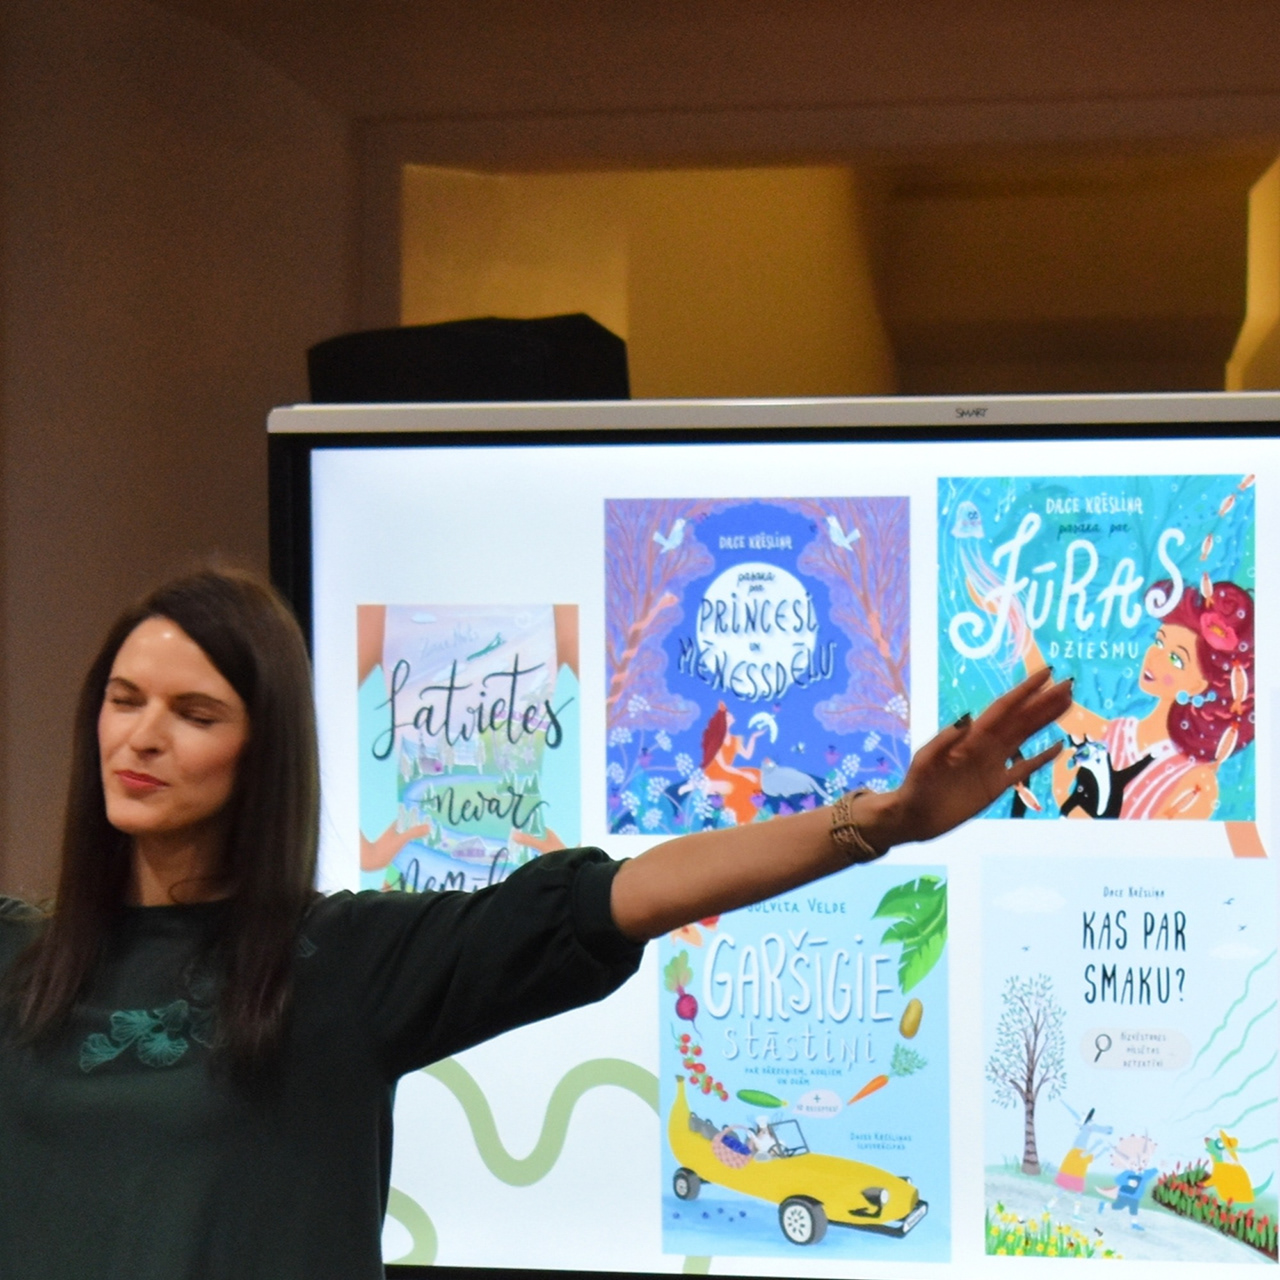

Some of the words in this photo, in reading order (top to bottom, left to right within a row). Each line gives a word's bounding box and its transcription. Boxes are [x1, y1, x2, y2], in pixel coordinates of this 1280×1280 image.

[955, 408, 988, 418] SMART
[1046, 498, 1080, 514] DACE
[719, 535, 745, 549] DACE
[948, 512, 1186, 660] JŪRAS
[1049, 640, 1140, 660] DZIESMU
[807, 898, 847, 914] VELDE
[1082, 909, 1128, 951] KAS
[1143, 910, 1186, 952] PAR
[1084, 963, 1186, 1006] SMAKU?
